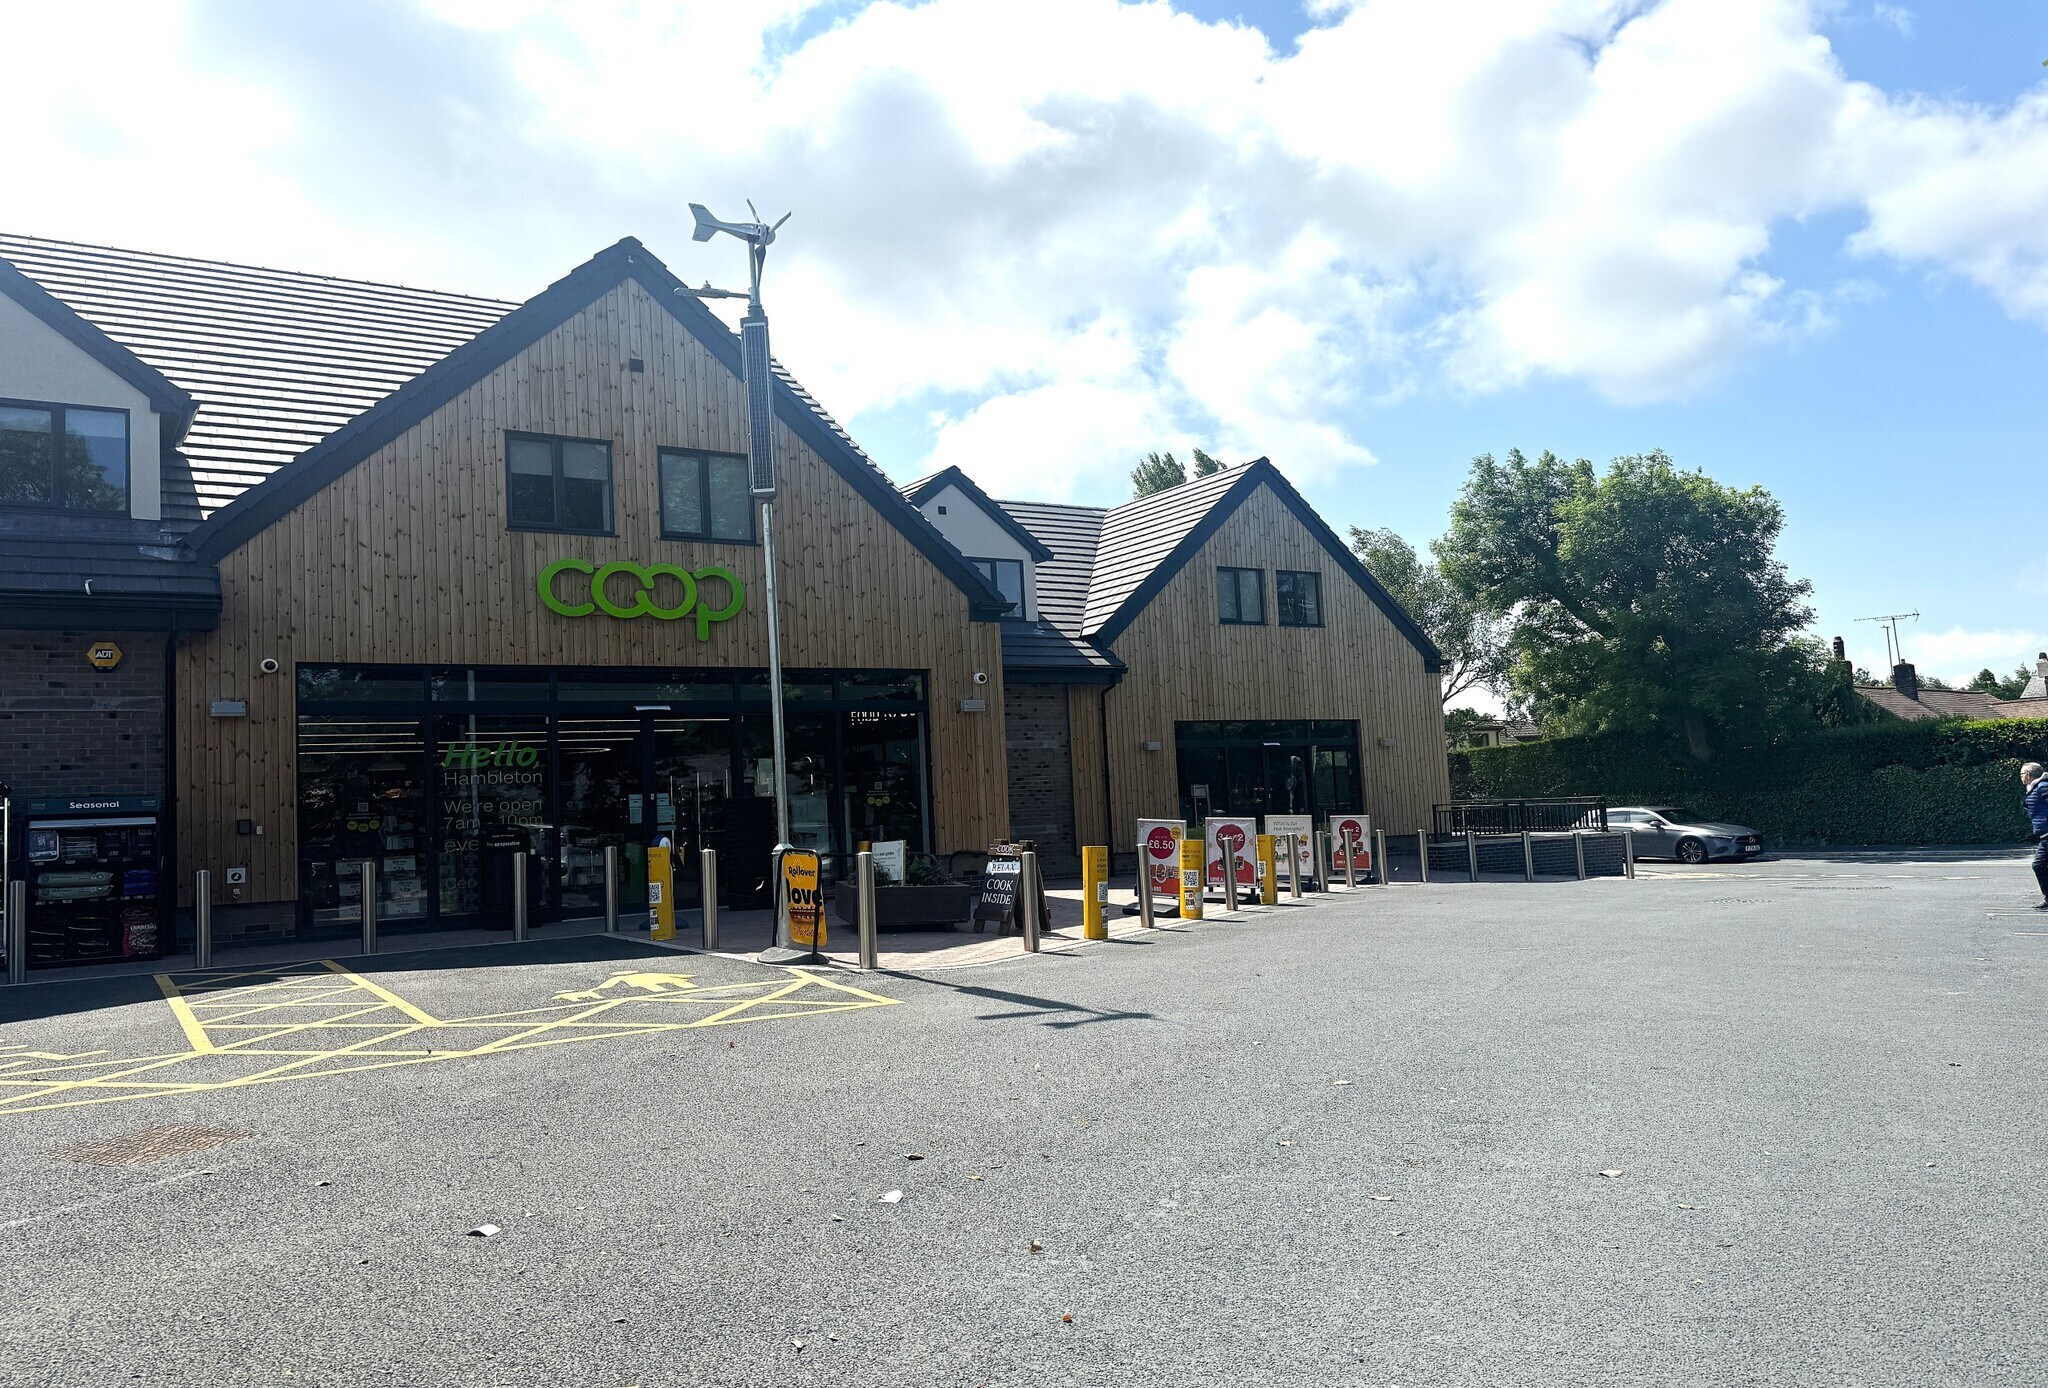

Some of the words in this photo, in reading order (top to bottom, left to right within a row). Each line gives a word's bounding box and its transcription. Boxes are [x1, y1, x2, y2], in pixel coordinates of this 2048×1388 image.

[95, 650, 114, 658] ADT
[442, 739, 540, 769] Hello,
[443, 770, 543, 786] Hambleton
[69, 801, 120, 809] Seasonal
[443, 800, 494, 814] Were
[499, 800, 542, 815] open
[443, 816, 481, 830] 7am
[1217, 833, 1224, 841] 3
[1237, 833, 1244, 842] 2
[444, 838, 480, 852] eve
[996, 845, 1014, 853] COOK
[1148, 840, 1175, 849] £6.50
[788, 866, 816, 877] Rollover
[991, 863, 1016, 872] RELAX
[986, 878, 1014, 891] COOK
[981, 892, 1013, 905] INSIDE
